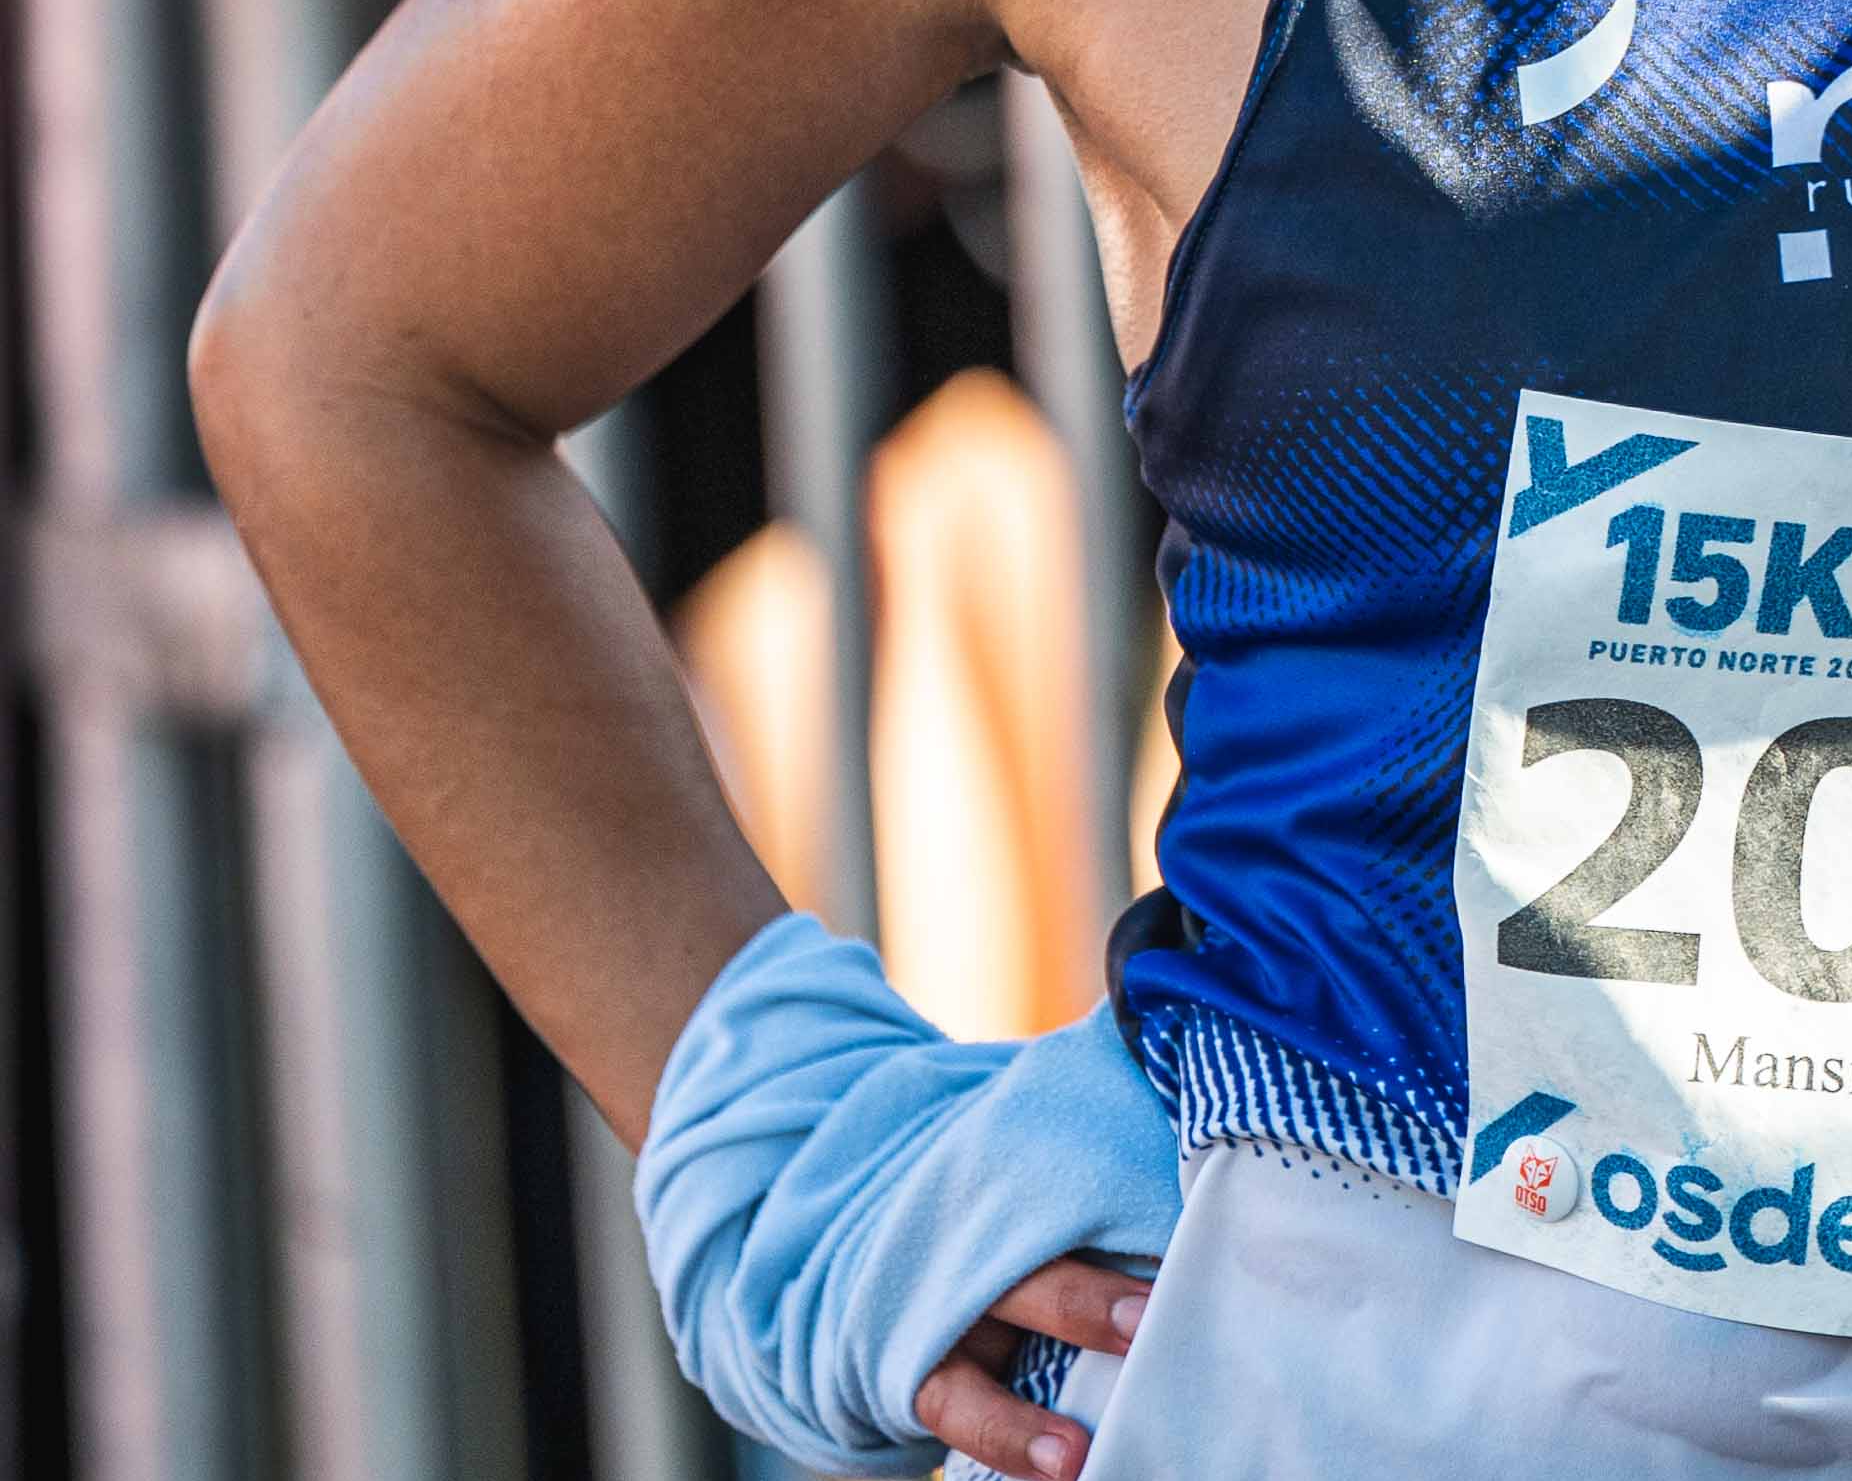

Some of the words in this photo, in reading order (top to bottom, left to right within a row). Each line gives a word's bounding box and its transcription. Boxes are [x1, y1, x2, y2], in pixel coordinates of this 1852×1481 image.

[1588, 639, 1707, 669] PUERTO
[1718, 650, 1816, 677] NORTE
[1516, 1183, 1547, 1213] OTSO
